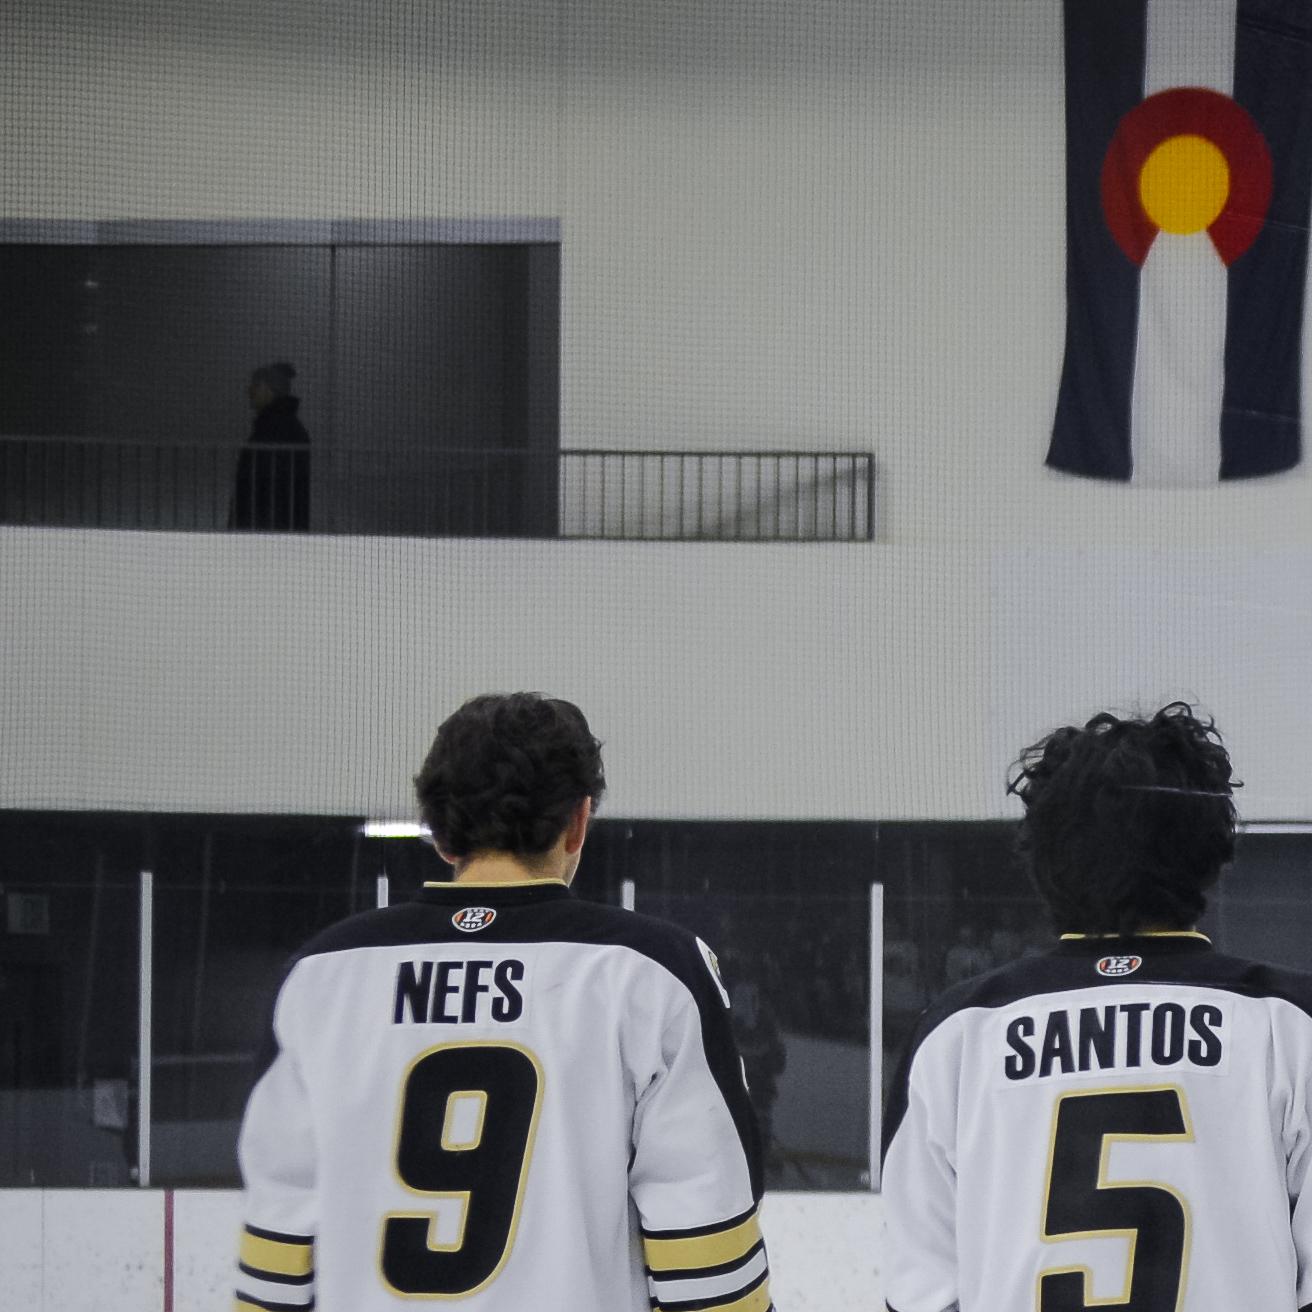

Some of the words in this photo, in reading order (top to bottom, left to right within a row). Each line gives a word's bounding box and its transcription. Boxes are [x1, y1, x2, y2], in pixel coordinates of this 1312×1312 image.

[393, 959, 524, 1025] NEFS
[1004, 1002, 1223, 1081] SANTOS
[378, 1040, 545, 1301] 9
